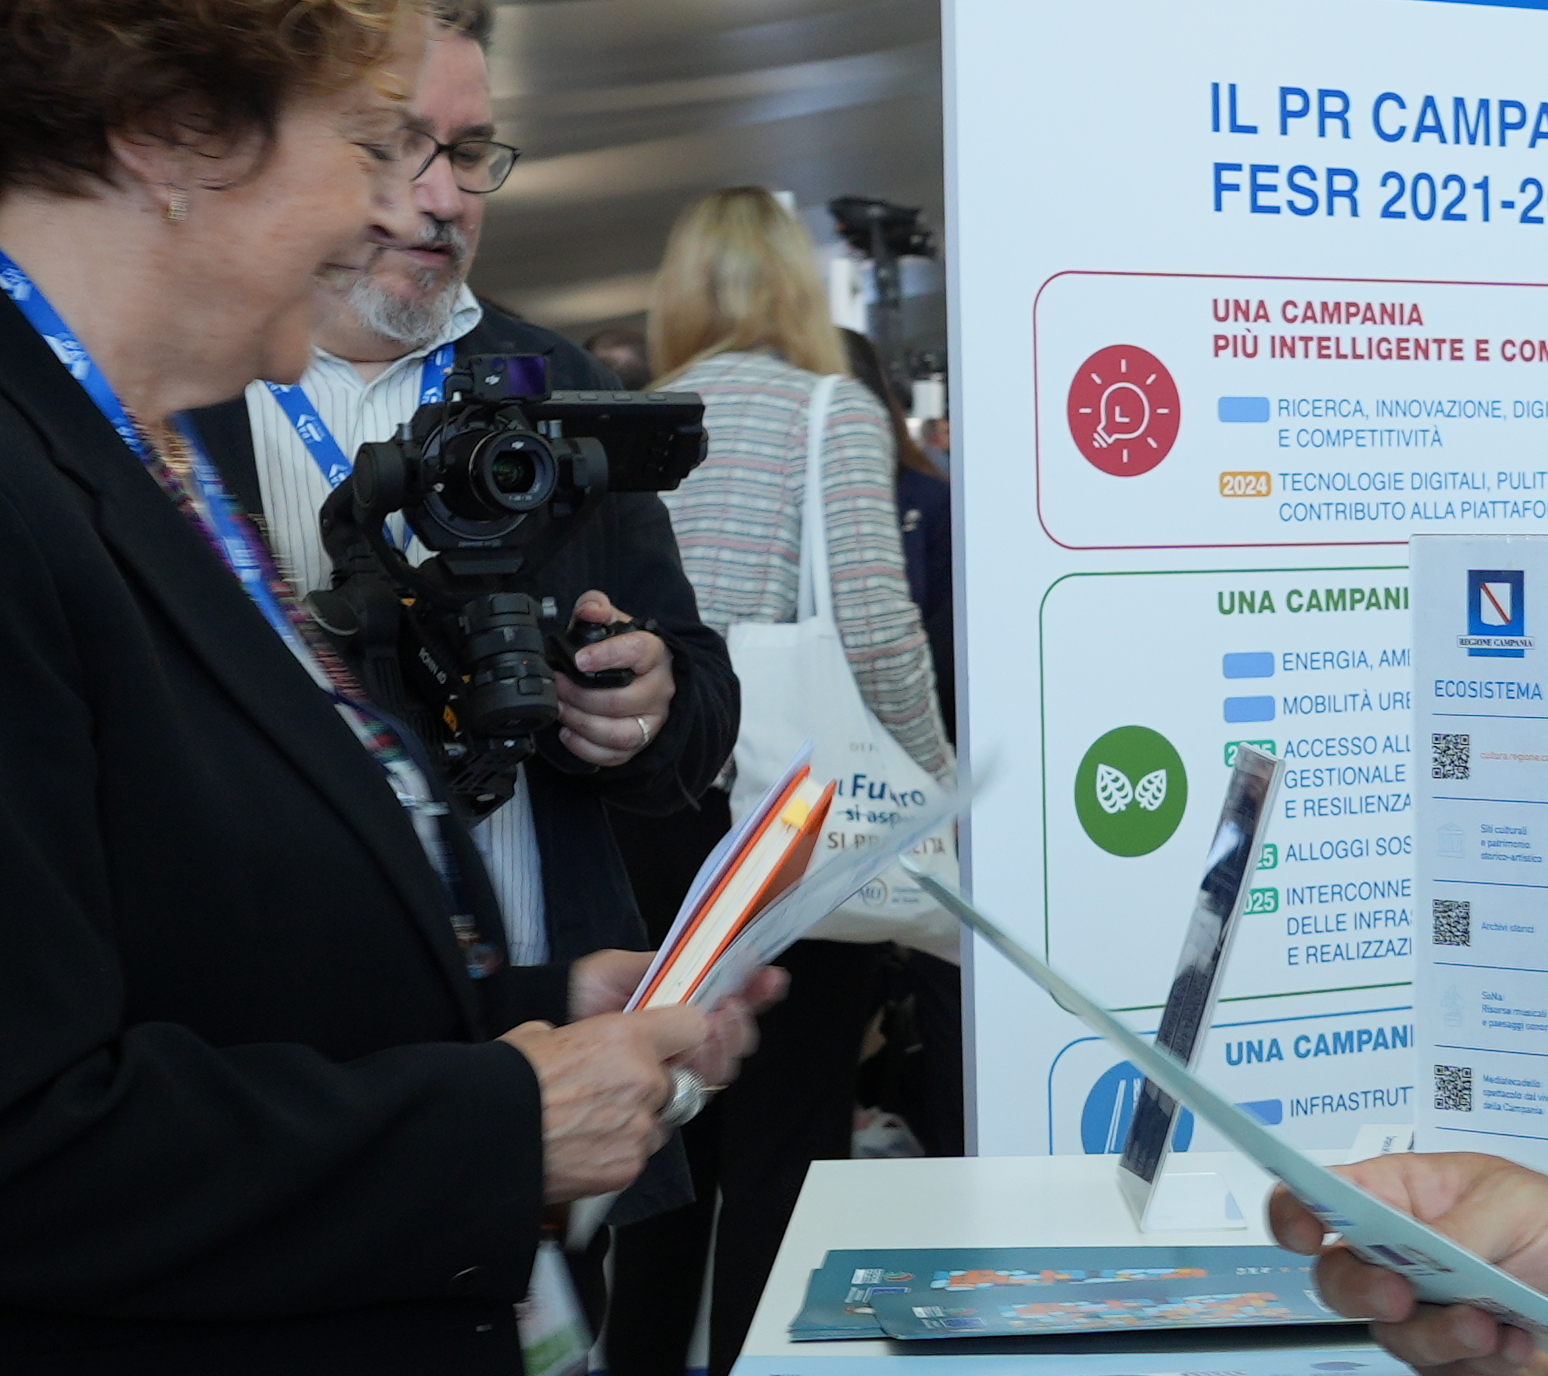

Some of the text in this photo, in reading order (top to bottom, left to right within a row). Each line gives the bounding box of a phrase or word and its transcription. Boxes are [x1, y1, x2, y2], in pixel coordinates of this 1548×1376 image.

[1211, 82, 1259, 134] IL
[1278, 86, 1352, 139] PR
[1213, 162, 1360, 217] FESR
[1212, 299, 1424, 326] UNA CAMPANIA
[1213, 329, 1258, 358] PIÙ
[1271, 336, 1465, 361] INTELLIGENTE
[1476, 339, 1490, 361] E
[1278, 399, 1370, 421] RICERCA,
[1376, 400, 1507, 421] INNOVAZIONE,
[1278, 425, 1442, 448] E COMPETITIVITÀ
[1222, 475, 1268, 495] 2024
[1279, 473, 1404, 491] TECNOLOGIE
[1410, 472, 1491, 493] DIGITALI,
[1279, 502, 1406, 522] CONTRIBUTO
[1411, 502, 1454, 520] ALLA
[1218, 587, 1409, 615] UNA CAMPANI
[1459, 638, 1533, 648] REGIONE CAMPANIA
[1283, 649, 1410, 671] ENERGIA, AM
[1434, 680, 1542, 700] ECOSISTEMA
[1283, 689, 1372, 715] MOBILITÀ
[1284, 736, 1377, 758] ACCESSO
[1285, 764, 1406, 788] GESTIONALE
[1286, 794, 1411, 818] E RESILIENZA
[1481, 824, 1527, 835] Siti culturali
[1285, 839, 1369, 862] ALLOGGI
[1487, 840, 1530, 849] patrimonio
[1481, 852, 1542, 863] storico-artistico
[1244, 891, 1275, 912] 025
[1287, 879, 1411, 906] INTERCONNE
[1287, 909, 1412, 935] DELLE INFRA
[1481, 922, 1535, 933] Archivi storici
[1288, 938, 1412, 965] E REALIZZAZI
[1225, 1039, 1284, 1066] UNA
[1291, 1086, 1413, 1117] INFRASTRUT
[1503, 1103, 1544, 1115] Campania
